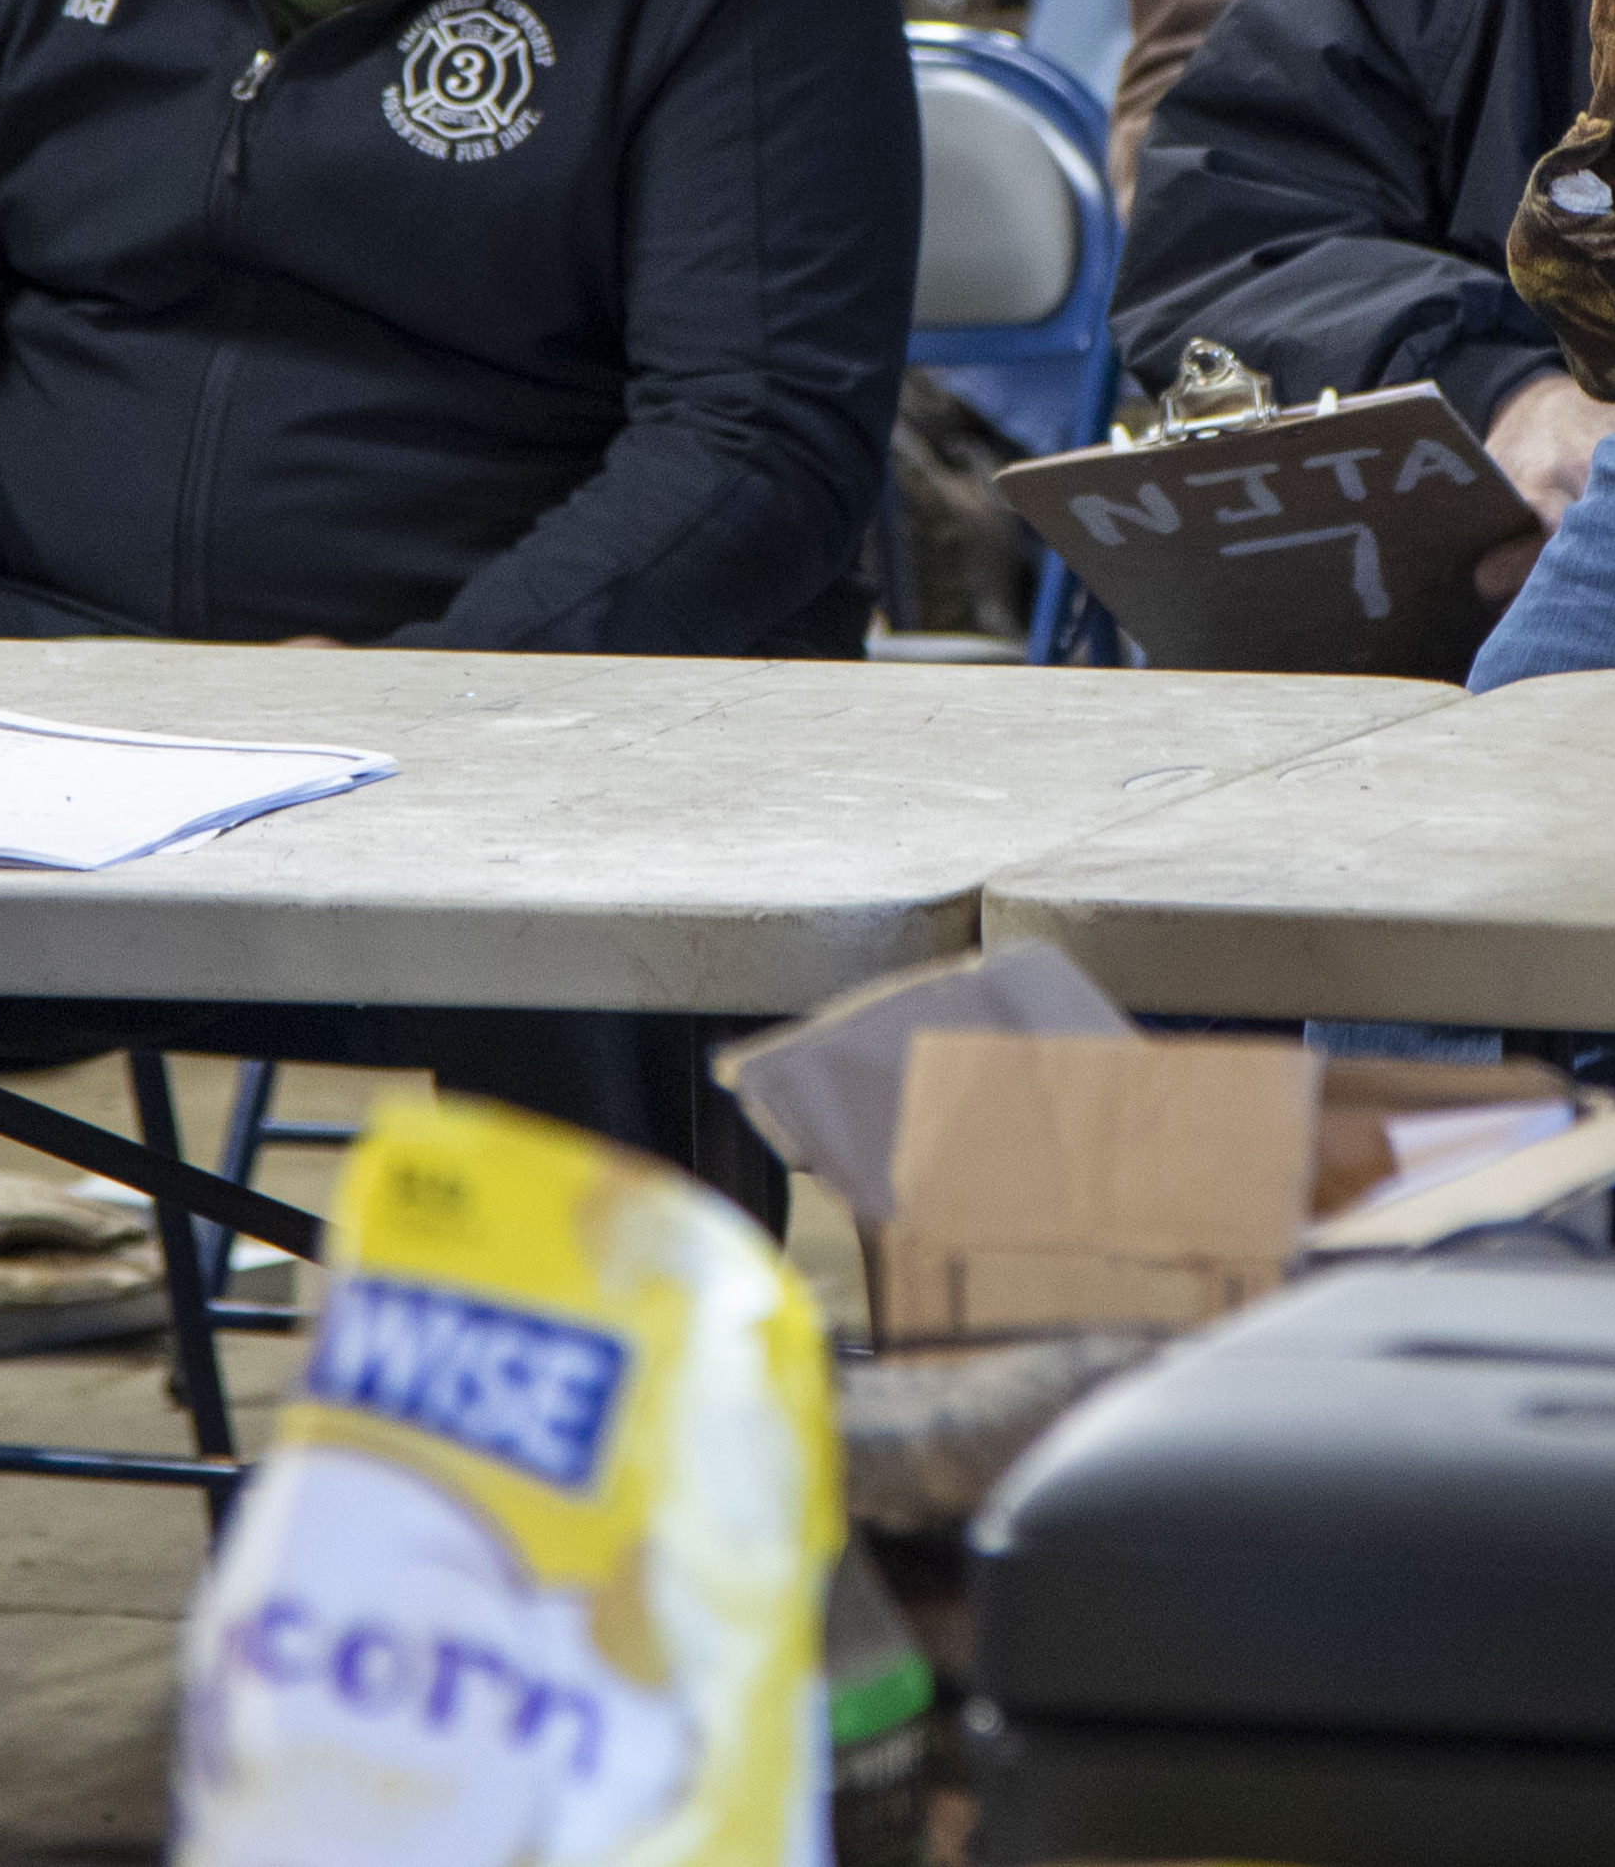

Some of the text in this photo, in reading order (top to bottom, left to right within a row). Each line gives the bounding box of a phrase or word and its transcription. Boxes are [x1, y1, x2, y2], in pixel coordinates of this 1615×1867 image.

[445, 49, 484, 99] 3
[455, 138, 498, 162] FIRE
[1220, 525, 1389, 619] 7
[328, 1288, 606, 1479] WISE
